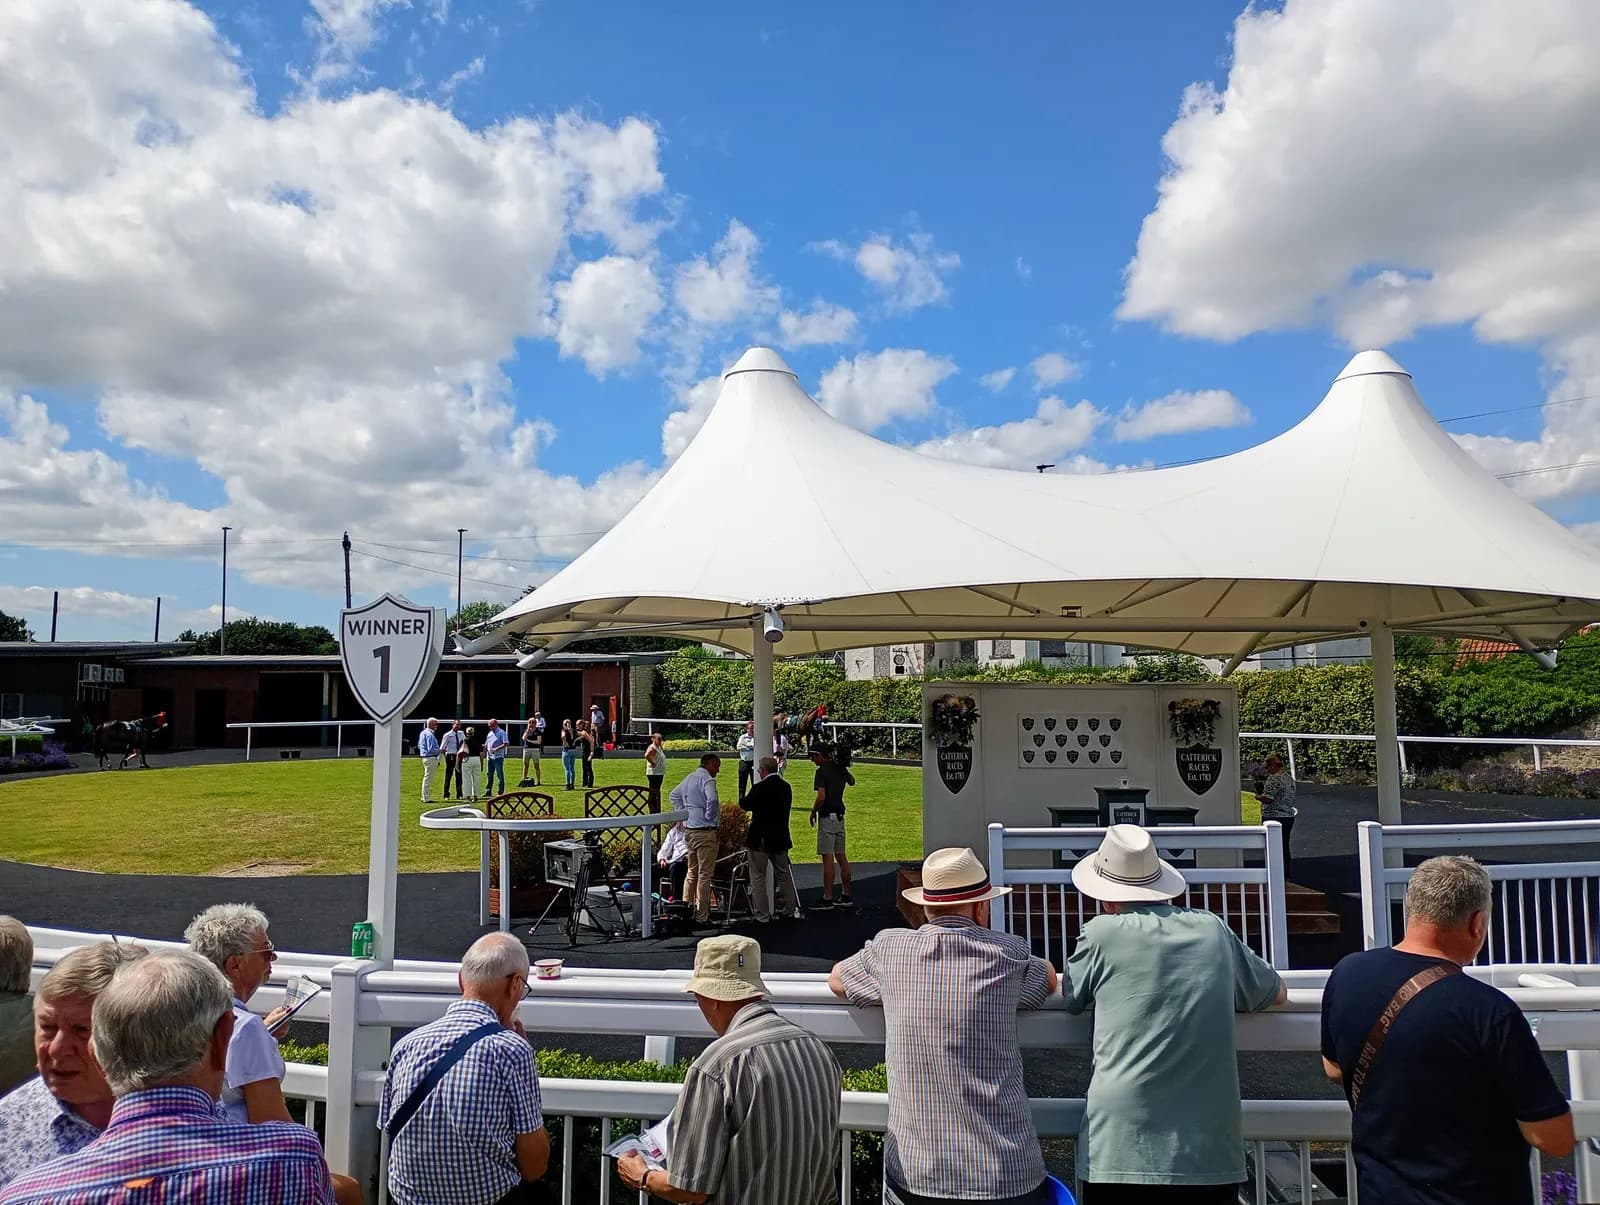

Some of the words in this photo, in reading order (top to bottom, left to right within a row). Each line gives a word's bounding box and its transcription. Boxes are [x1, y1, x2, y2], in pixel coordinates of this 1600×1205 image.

[348, 619, 425, 636] WINNER
[373, 645, 391, 693] 1
[940, 752, 969, 760] CATTERICK
[1180, 753, 1217, 761] CATTERICK
[946, 762, 964, 770] RACES
[1188, 763, 1210, 771] RACES
[352, 928, 371, 940] rite
